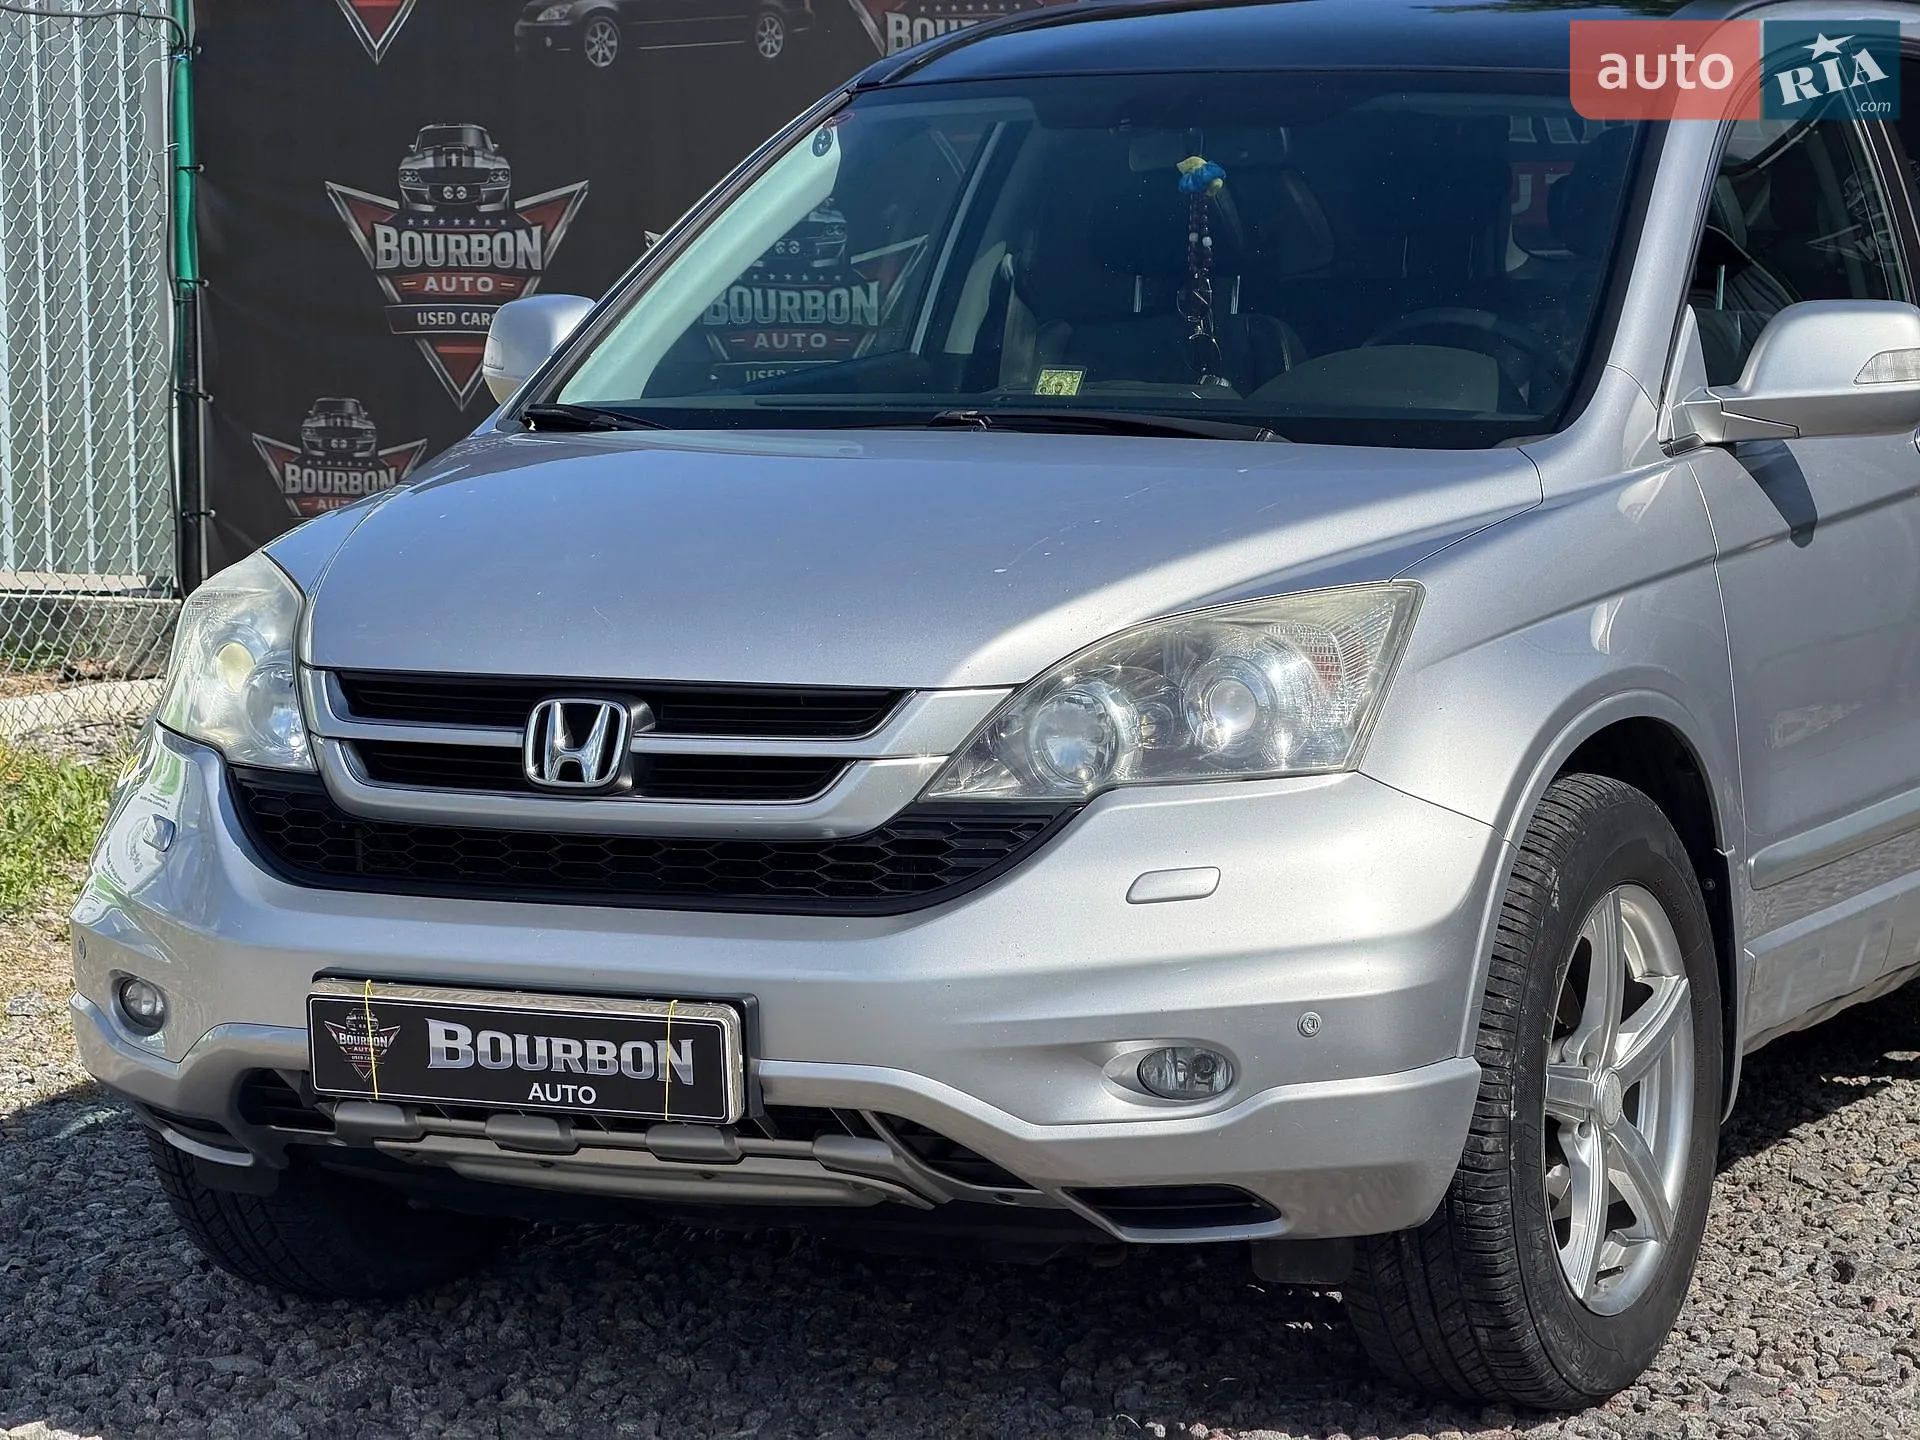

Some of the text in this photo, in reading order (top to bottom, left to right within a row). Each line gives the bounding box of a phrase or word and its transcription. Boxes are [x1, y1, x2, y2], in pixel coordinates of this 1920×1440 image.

[375, 223, 542, 270] BOURBON
[424, 276, 494, 293] AUTO
[703, 281, 880, 326] BOURBON
[417, 312, 495, 326] USED CAR
[753, 333, 827, 348] AUTO
[285, 462, 397, 495] BOURBON
[317, 499, 350, 510] AU
[424, 1018, 694, 1086] BOURBON
[528, 1082, 597, 1104] AUTO
